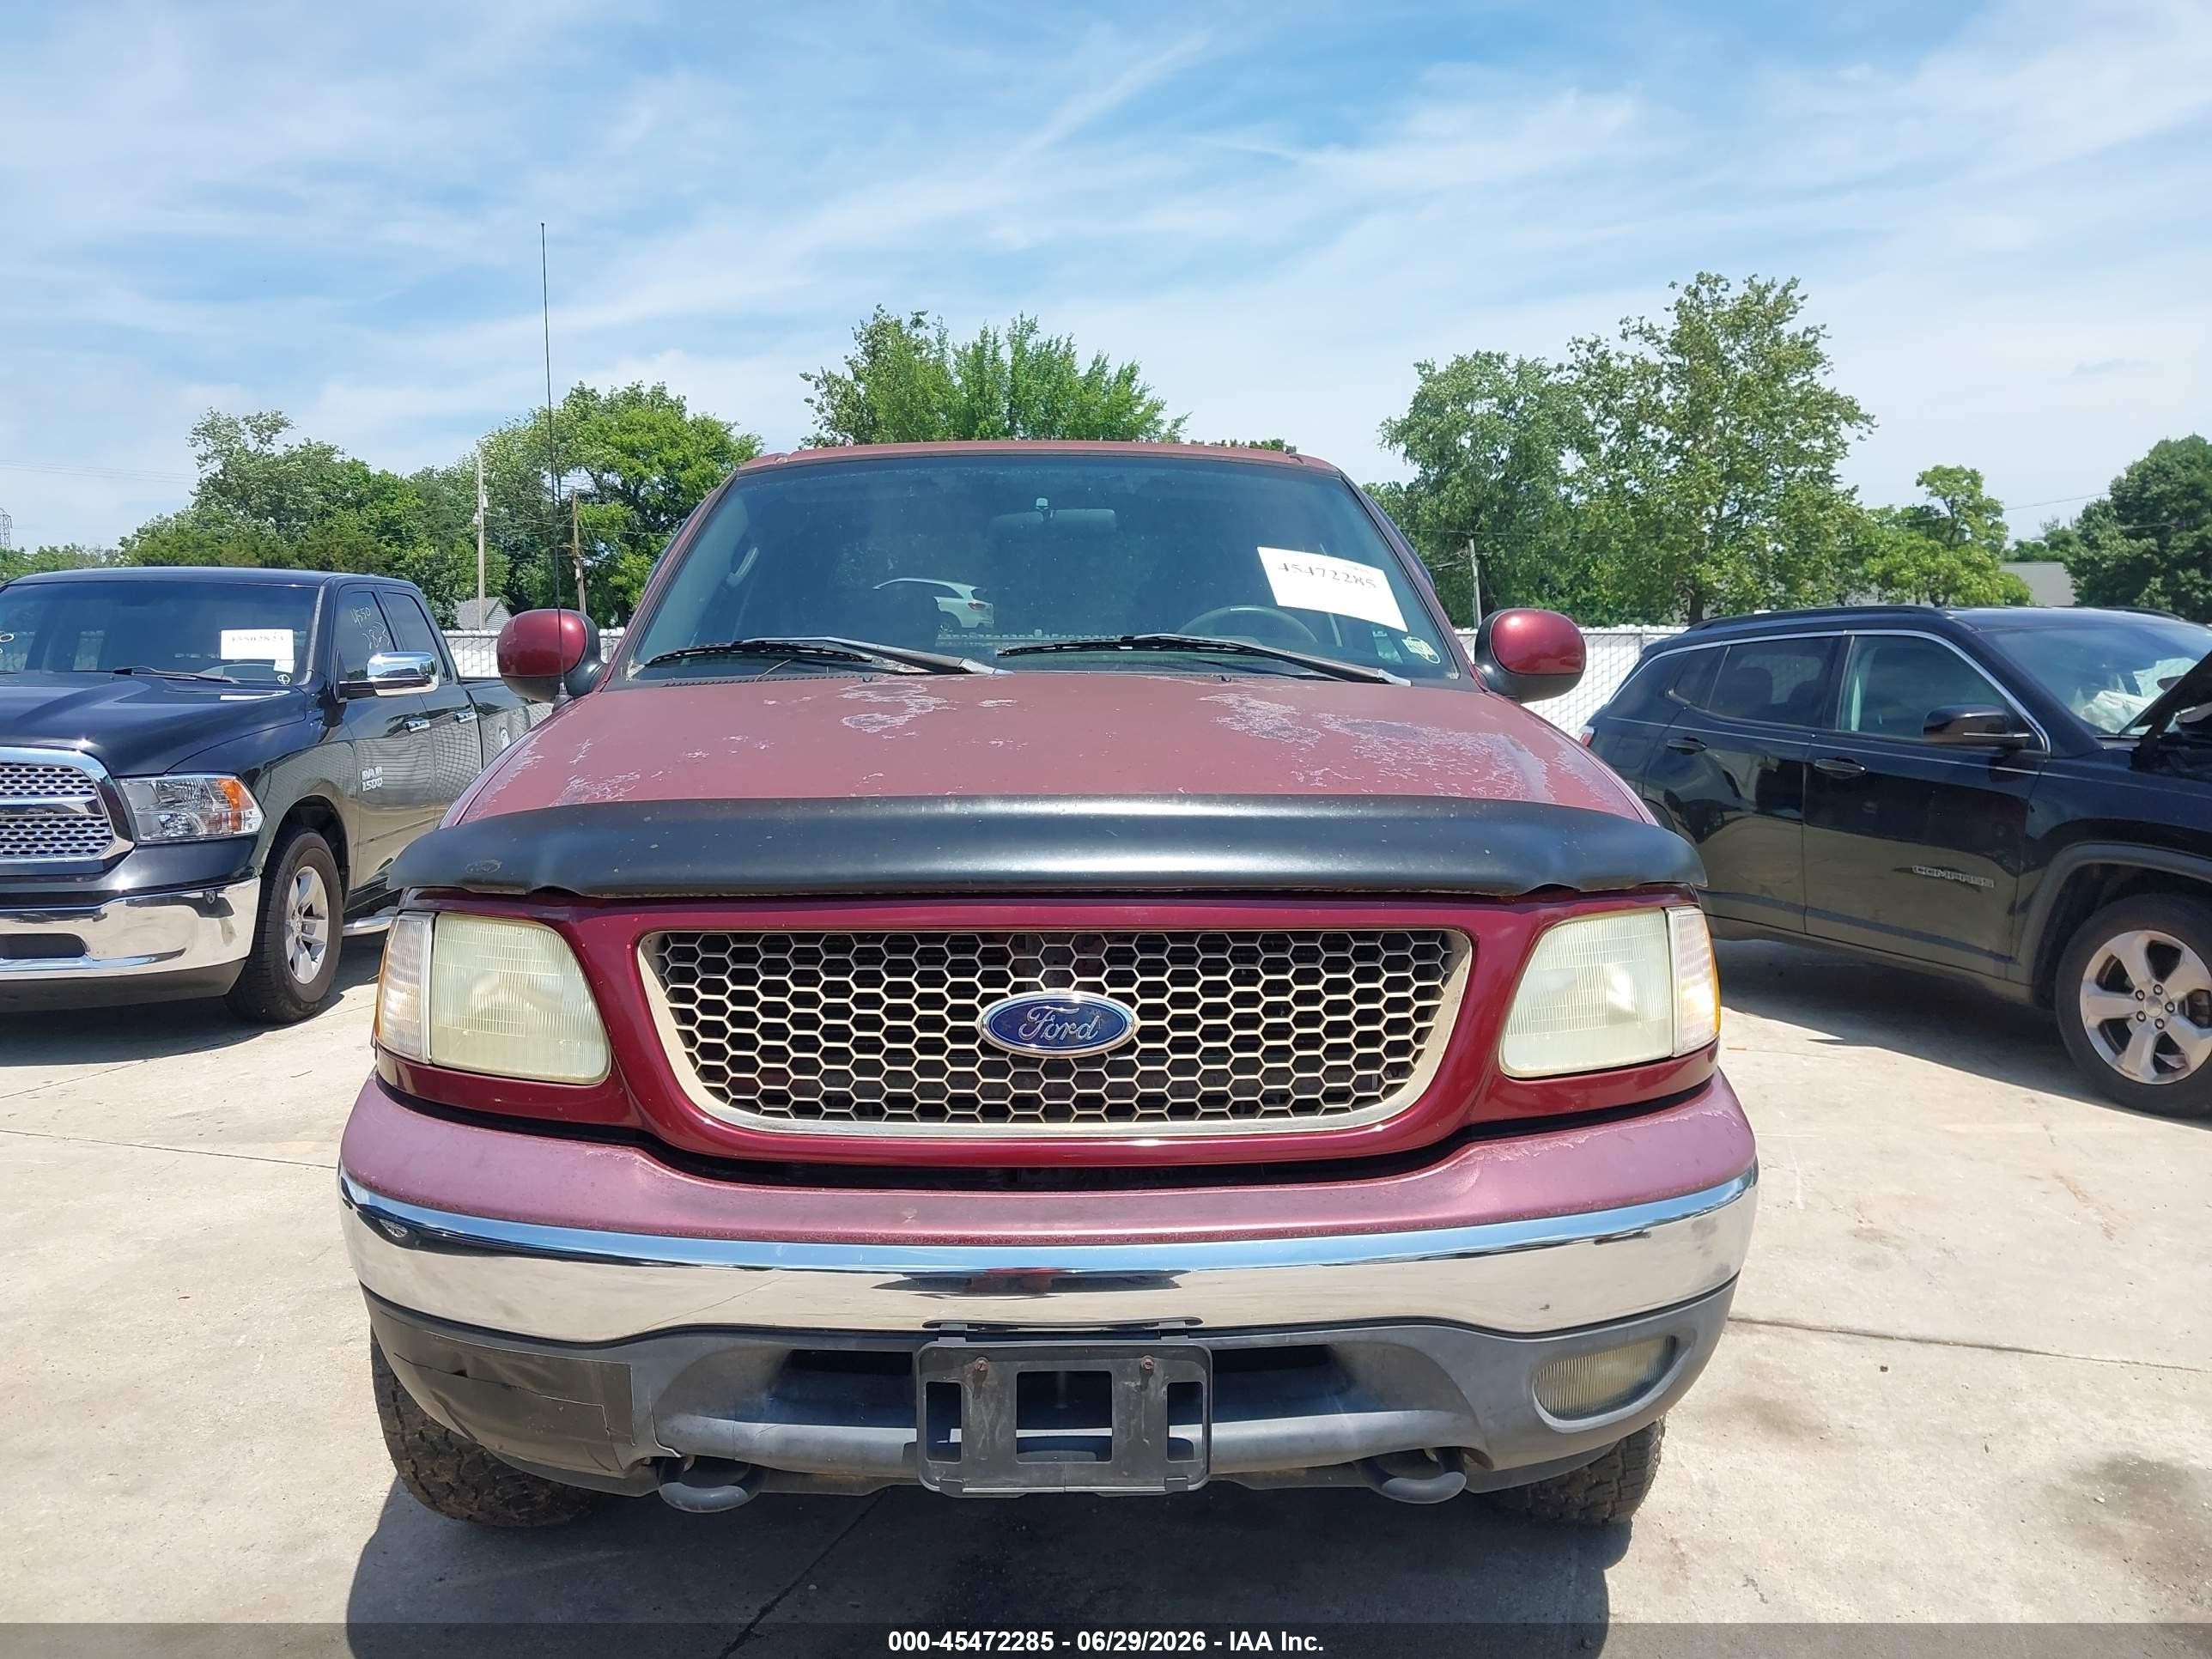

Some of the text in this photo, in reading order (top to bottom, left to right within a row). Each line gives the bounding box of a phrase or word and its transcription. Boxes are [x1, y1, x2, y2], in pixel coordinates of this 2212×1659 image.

[1278, 562, 1377, 589] 45472285
[362, 777, 383, 792] 1500
[1018, 1005, 1101, 1042] Ford
